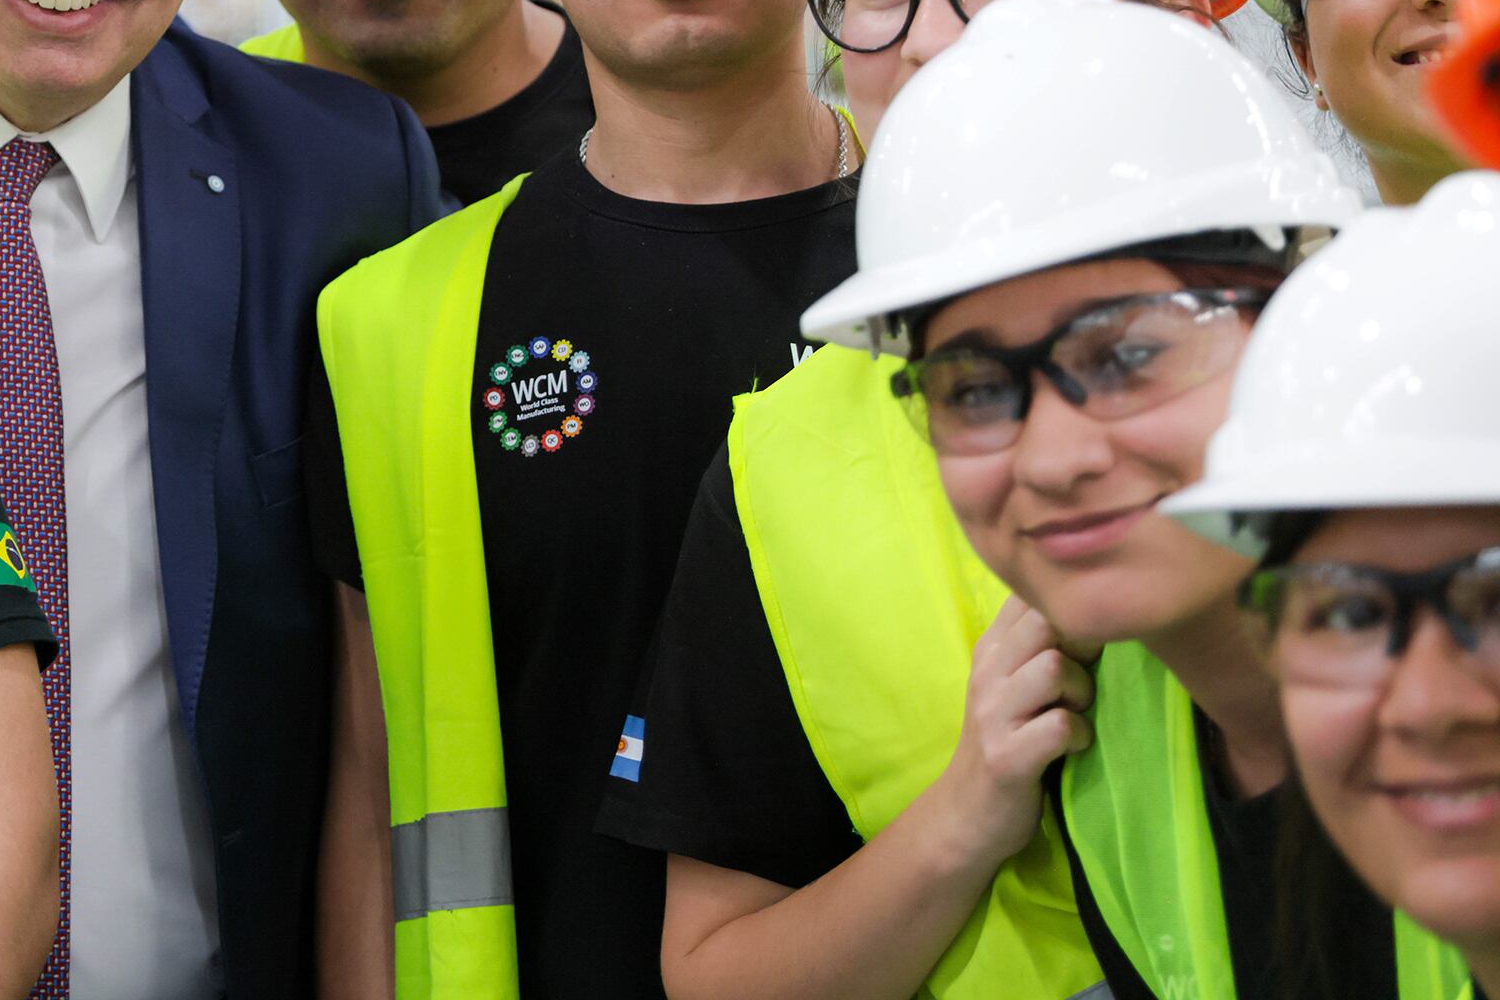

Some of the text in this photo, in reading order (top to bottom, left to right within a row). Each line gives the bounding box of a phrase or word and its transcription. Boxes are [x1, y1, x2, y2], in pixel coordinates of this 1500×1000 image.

[511, 370, 567, 404] WCM
[520, 398, 559, 411] World Class
[517, 405, 566, 421] Manufacturing
